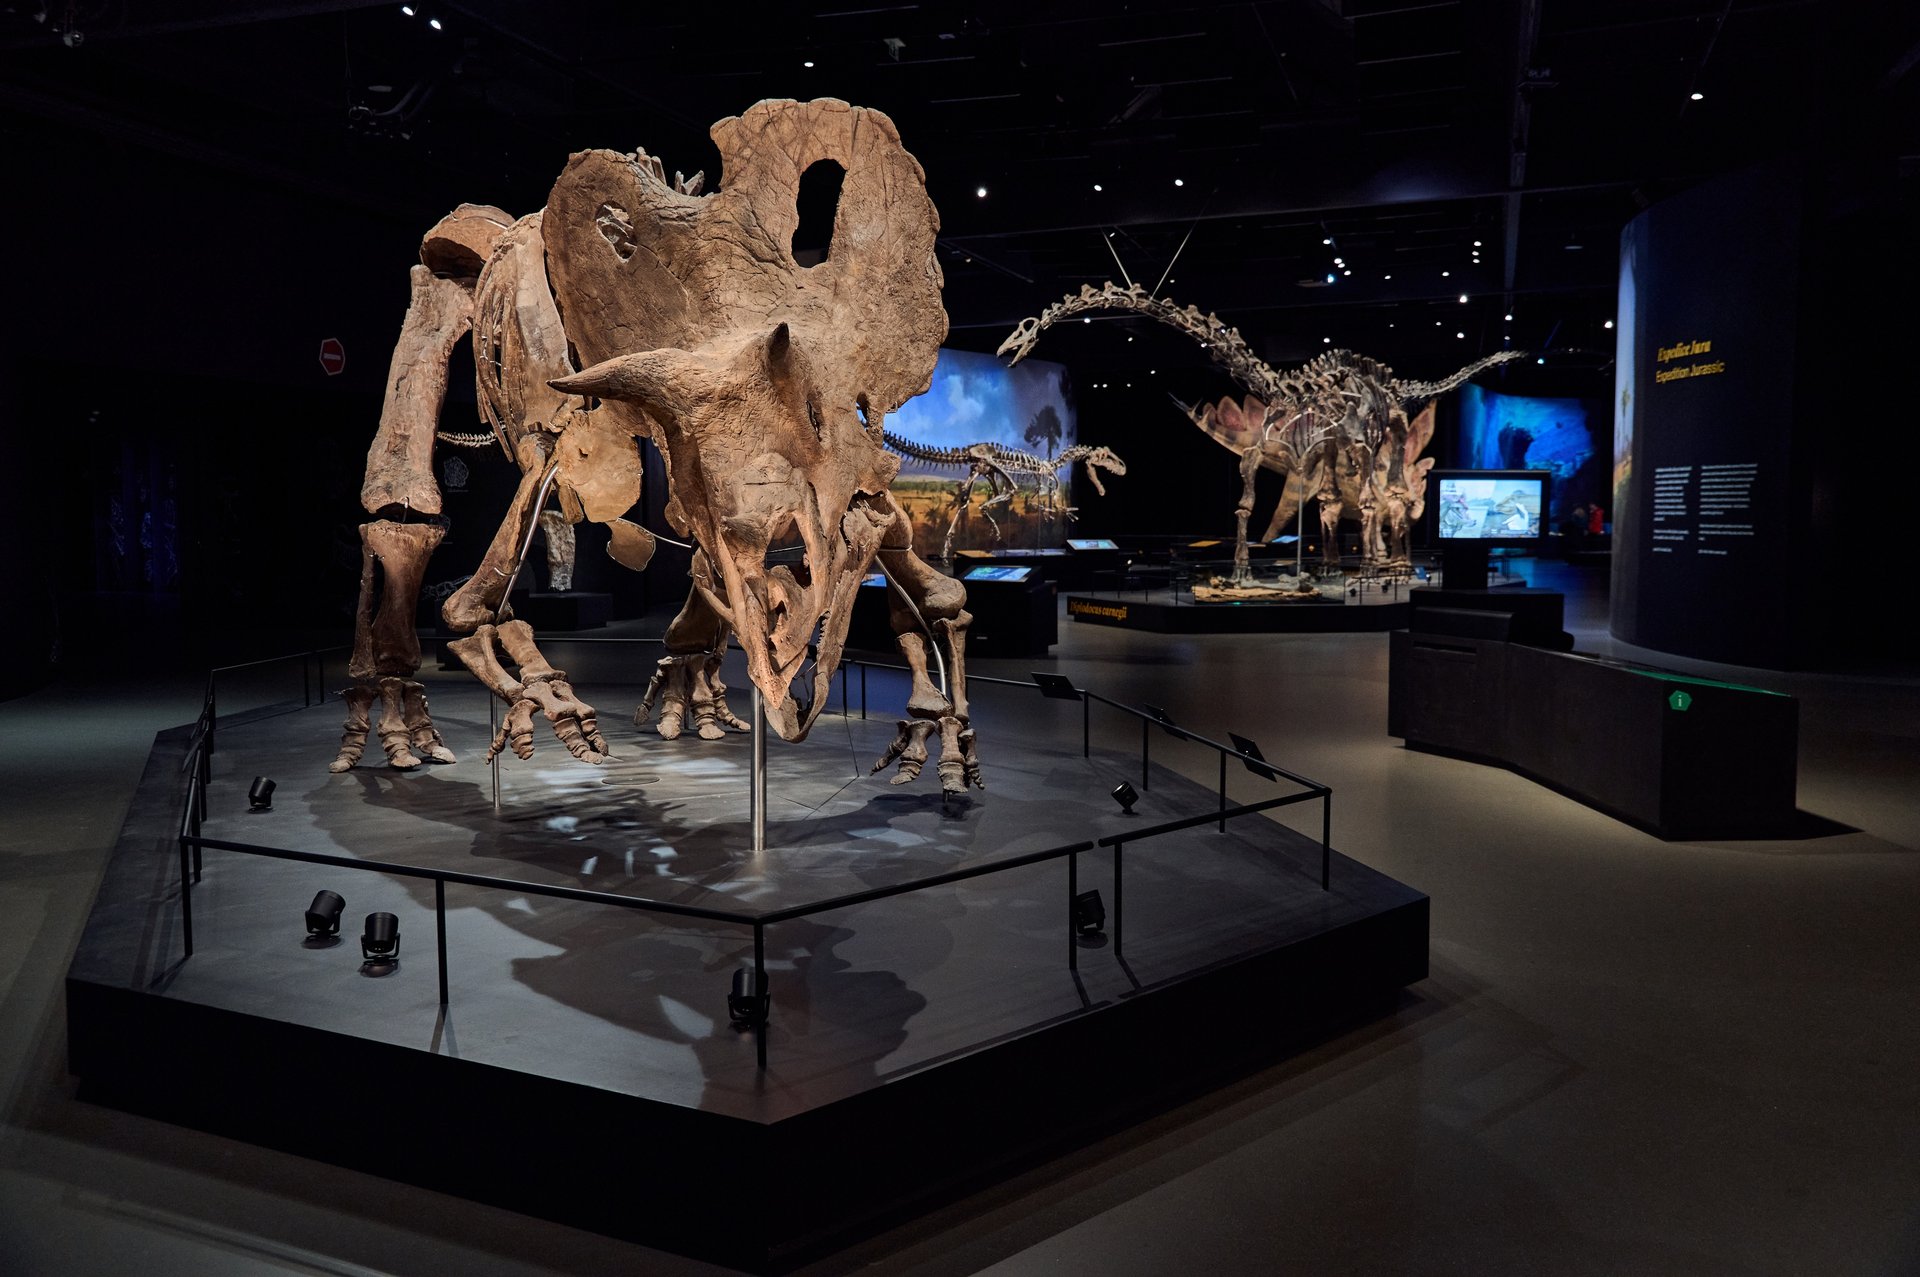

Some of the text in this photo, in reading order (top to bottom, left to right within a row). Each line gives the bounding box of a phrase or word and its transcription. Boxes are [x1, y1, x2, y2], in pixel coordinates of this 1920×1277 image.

[1690, 340, 1712, 355] Jura
[1656, 360, 1725, 384] Expedition Jurassic
